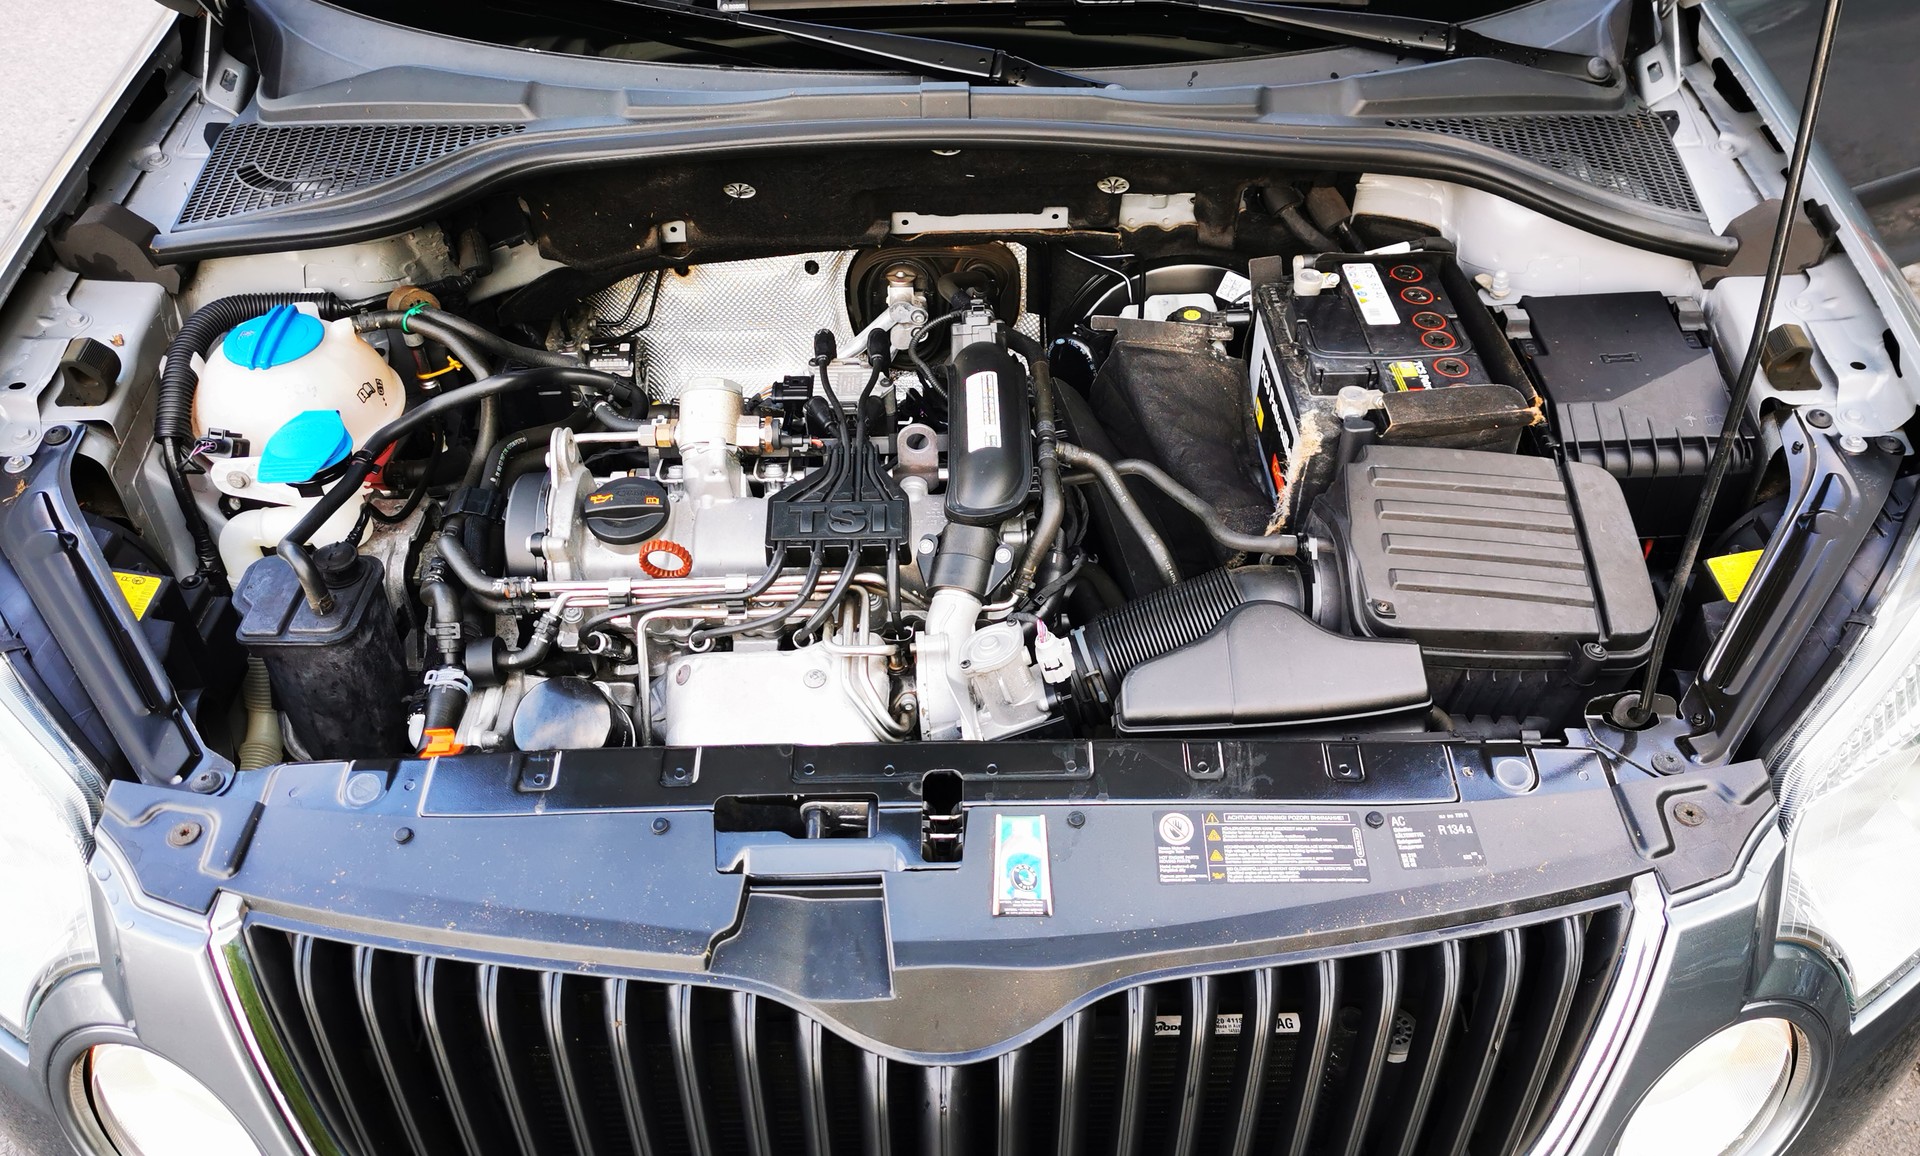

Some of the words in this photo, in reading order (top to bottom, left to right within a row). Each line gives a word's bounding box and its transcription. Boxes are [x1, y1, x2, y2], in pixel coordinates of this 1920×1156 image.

[788, 504, 888, 534] TSI
[1391, 816, 1406, 827] AC
[1438, 825, 1448, 835] R
[1447, 824, 1465, 835] 134
[1465, 825, 1474, 834] a
